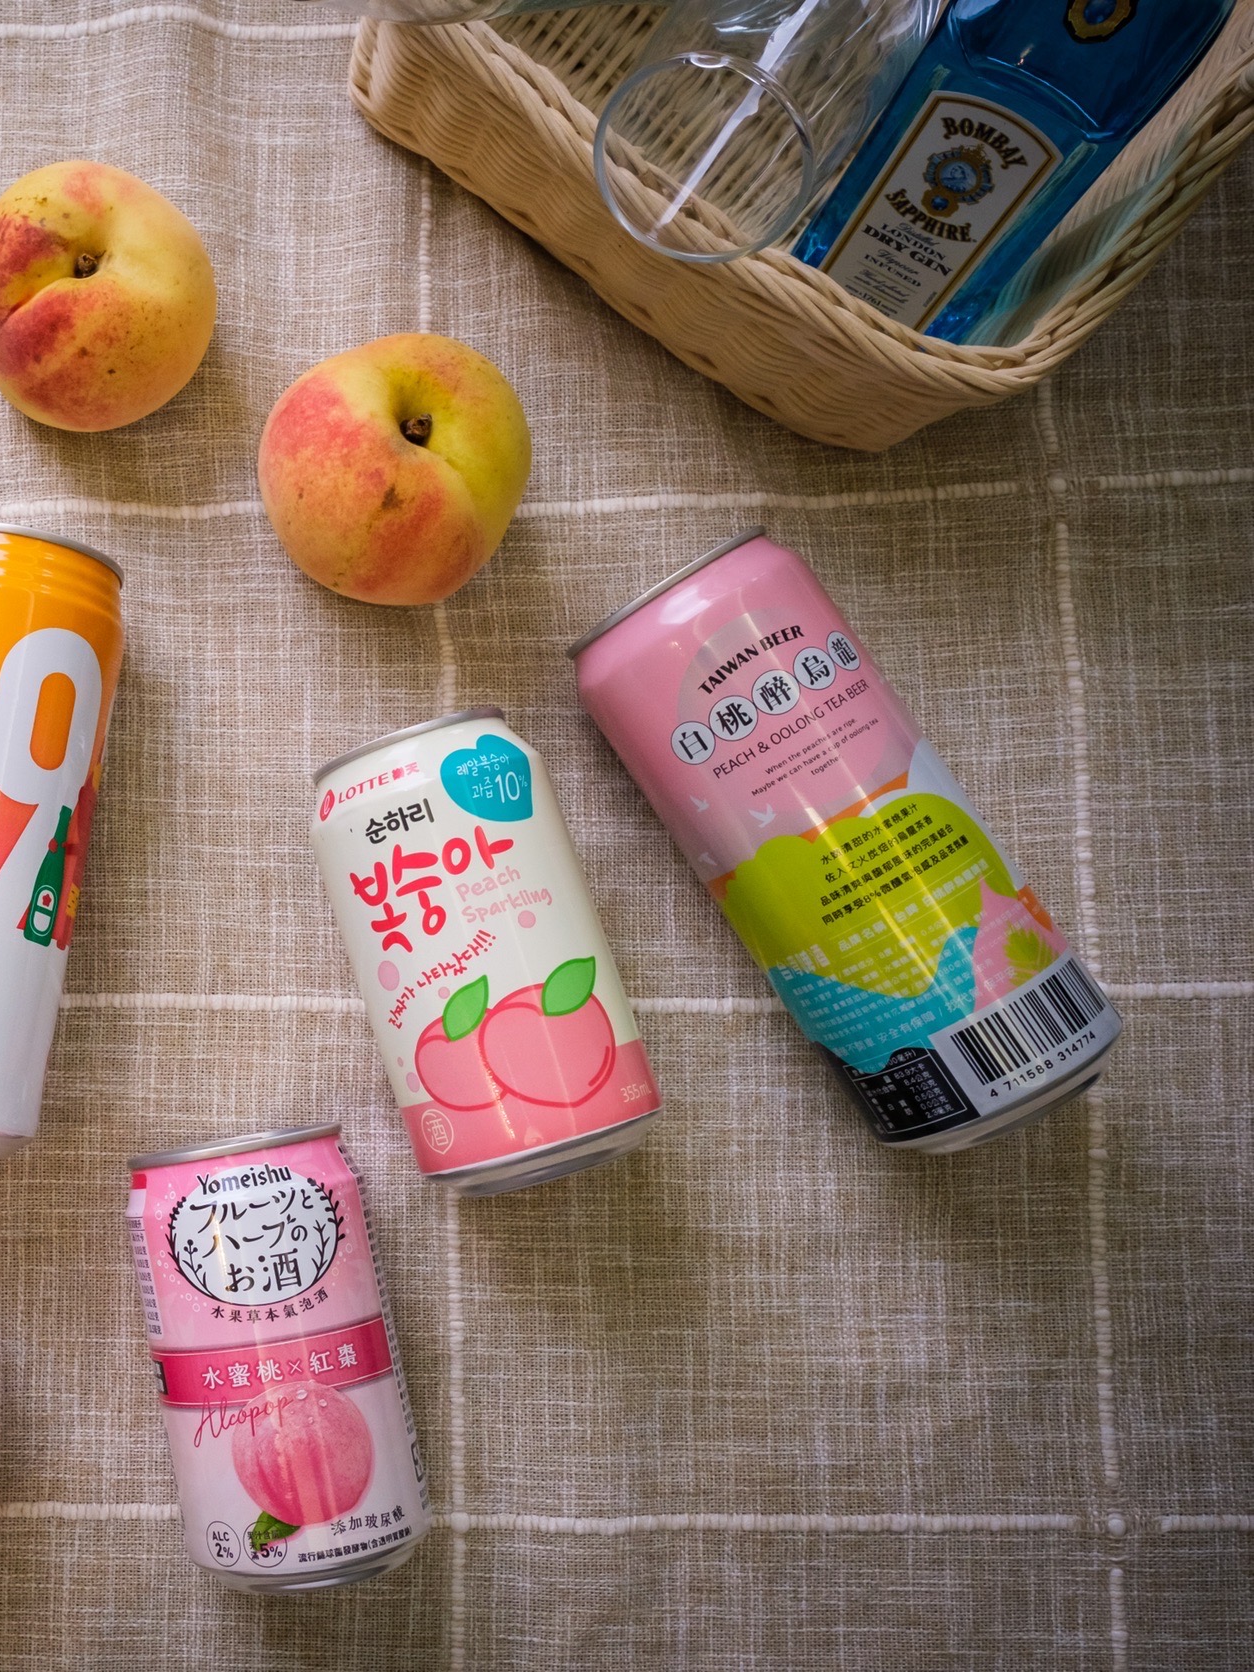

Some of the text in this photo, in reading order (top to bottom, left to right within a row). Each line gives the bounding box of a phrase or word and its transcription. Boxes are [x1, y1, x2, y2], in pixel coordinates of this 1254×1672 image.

[941, 117, 1028, 169] BOMBAY
[884, 188, 973, 242] SAPPHIRE
[861, 224, 953, 277] DRY GIN
[881, 223, 946, 260] LONDON
[864, 254, 921, 287] INFUSED
[697, 624, 805, 695] TAIWAN BEER
[712, 678, 871, 779] PEACH & OOLONG TEA BEER
[764, 759, 788, 775] When
[788, 751, 802, 763] the
[801, 733, 832, 756] peaches
[831, 726, 844, 737] are
[751, 779, 776, 797] Maybe
[776, 772, 789, 782] we
[788, 765, 803, 776] can
[802, 753, 822, 769] have
[827, 741, 841, 754] cup
[841, 736, 849, 745] of
[848, 723, 871, 740] oolong
[869, 717, 880, 727] tea
[338, 772, 390, 804] LOTTE
[471, 776, 494, 799] 과즙
[364, 797, 435, 845] 순하리
[349, 825, 515, 954] 복숭아
[455, 865, 522, 903] Peach
[461, 887, 553, 924] Sparkling
[388, 986, 416, 1030] 진짜가
[990, 1030, 1096, 1098] 4 711588 314774
[426, 1116, 448, 1148] 酒
[196, 1163, 293, 1196] Yomeishu
[189, 1187, 315, 1234] フルーツと
[201, 1214, 309, 1259] ハーブの
[224, 1247, 303, 1292] お酒
[210, 1286, 330, 1324] 水果草本氣泡酒
[193, 1394, 295, 1448] Alcopop
[212, 1530, 230, 1542] ALC
[330, 1504, 406, 1537] 添加玻尿酸
[214, 1542, 234, 1560] 2%
[259, 1543, 283, 1559] 5%
